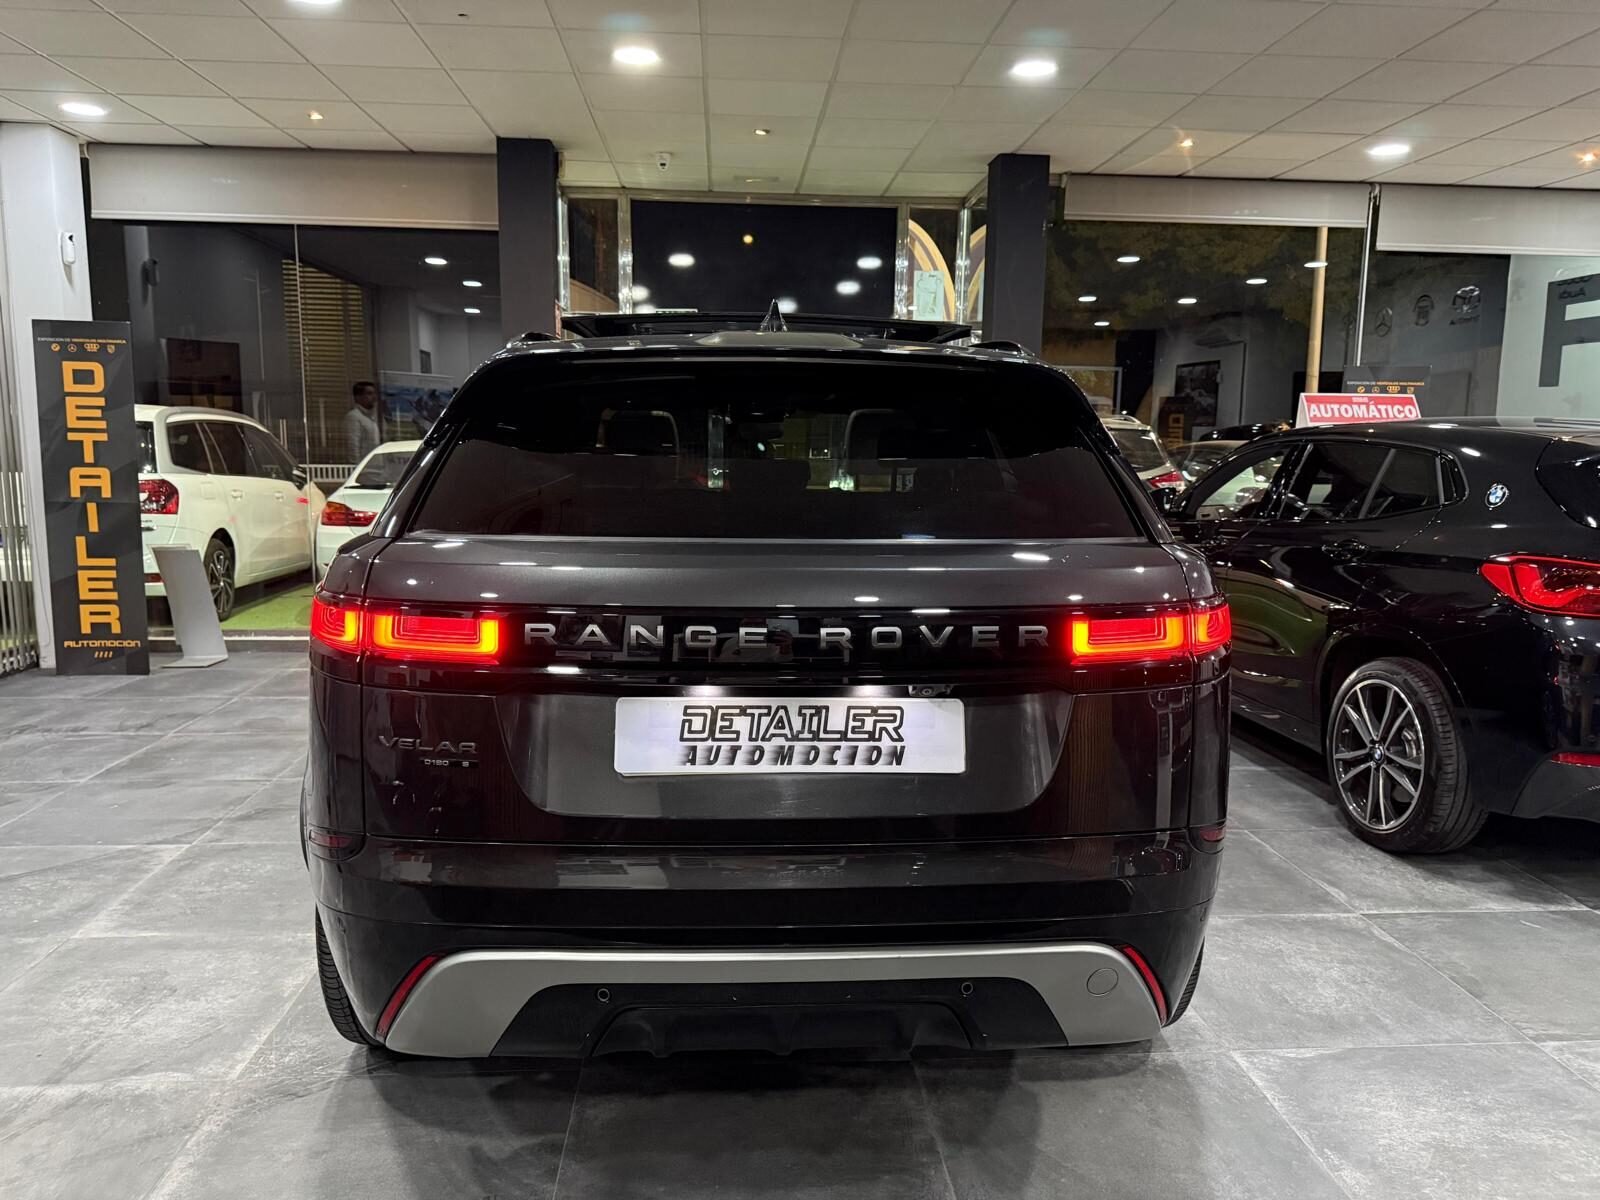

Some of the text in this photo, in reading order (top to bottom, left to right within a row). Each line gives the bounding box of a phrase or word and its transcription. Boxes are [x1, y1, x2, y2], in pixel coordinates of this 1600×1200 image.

[1309, 401, 1417, 418] AUTOMÁTICO
[61, 361, 121, 634] DETAILER
[524, 622, 1050, 650] RANGE ROVER
[679, 705, 905, 742] DETAILER
[378, 735, 478, 754] VELAR
[682, 744, 905, 767] AUTOMOCION
